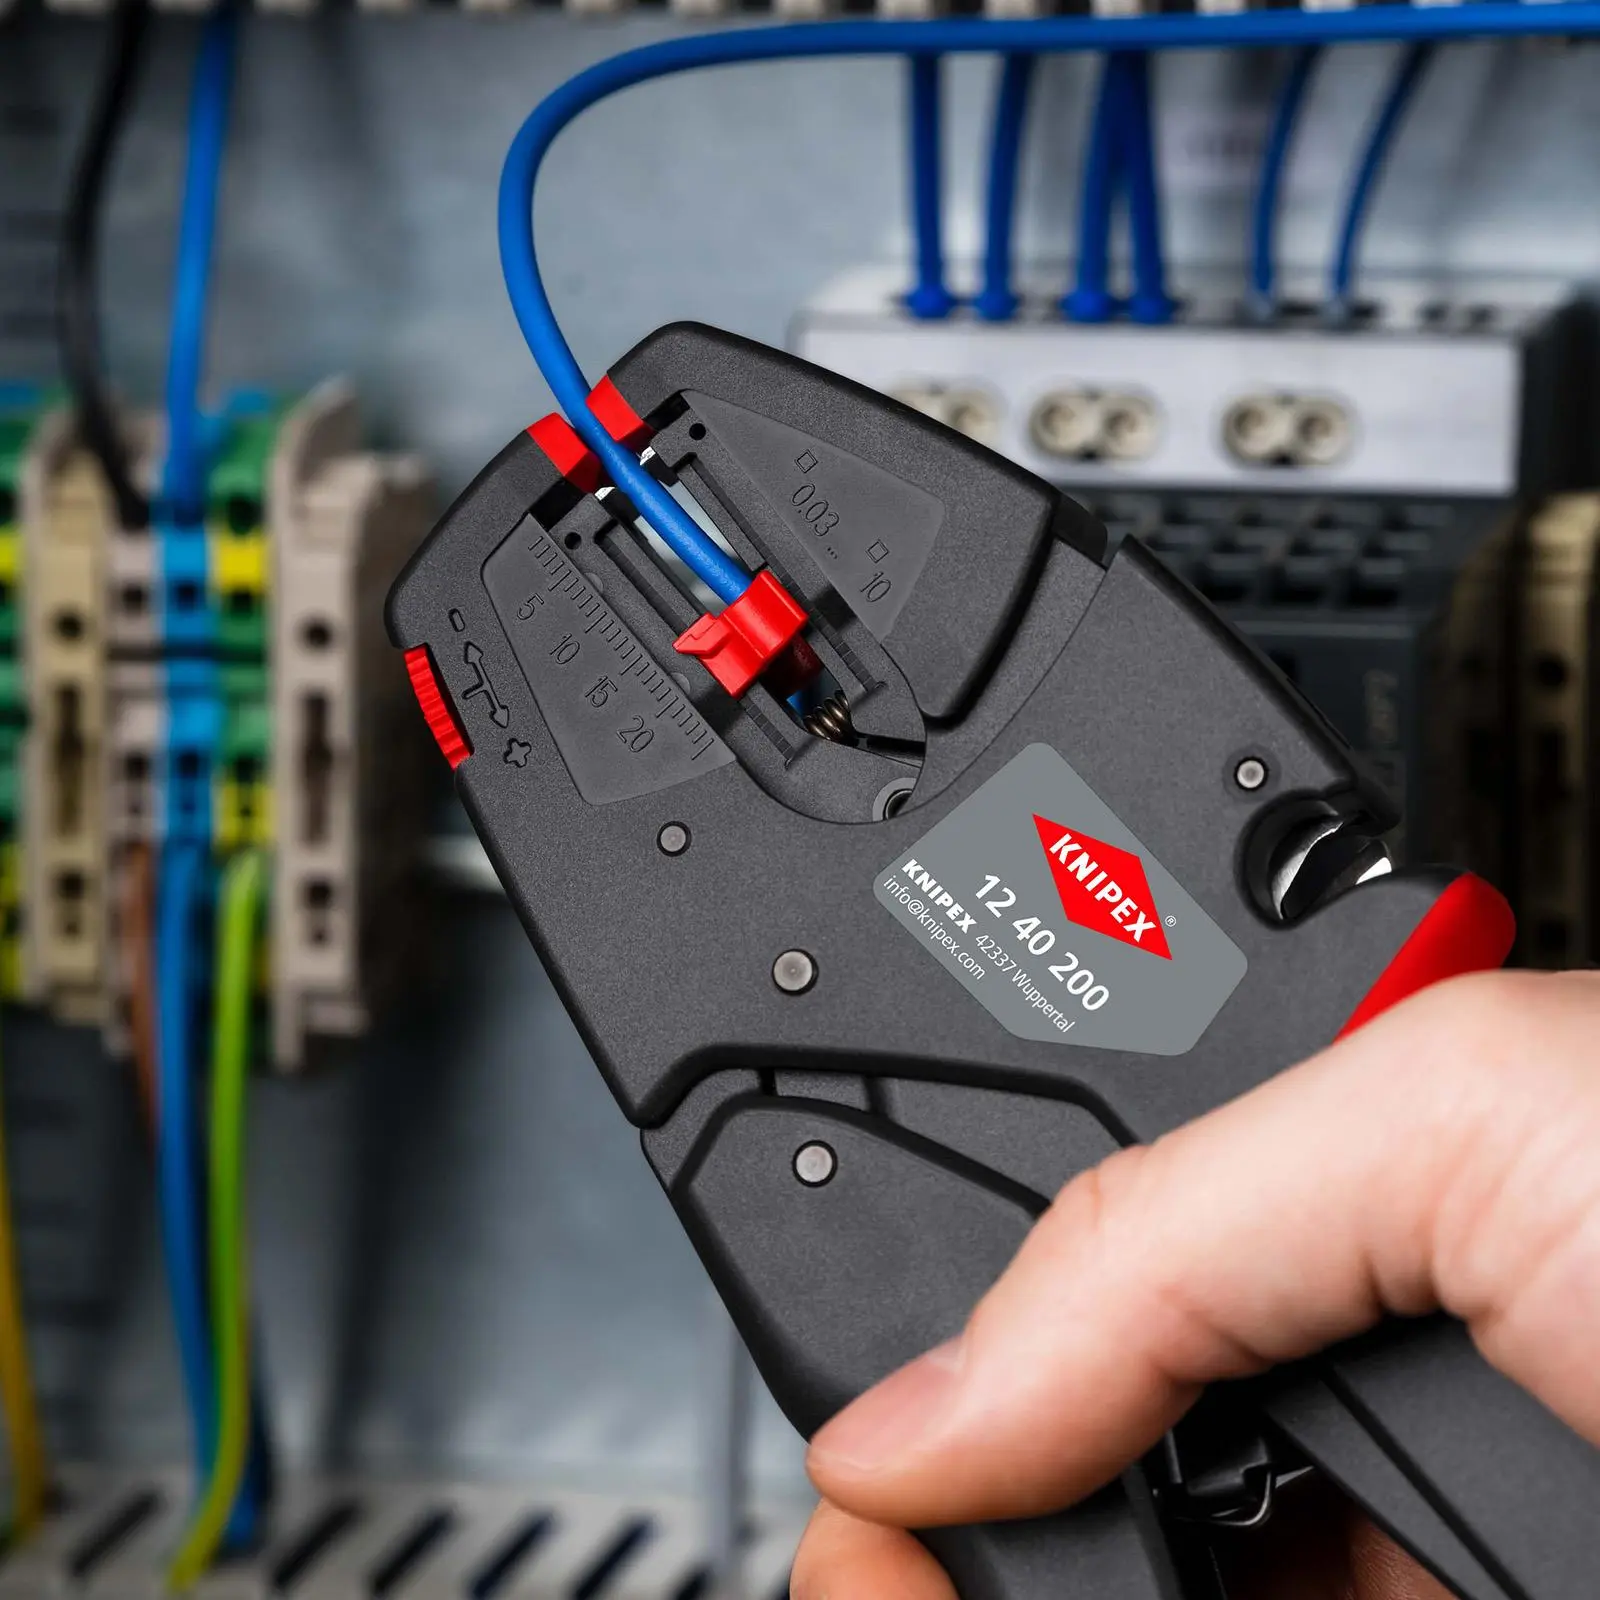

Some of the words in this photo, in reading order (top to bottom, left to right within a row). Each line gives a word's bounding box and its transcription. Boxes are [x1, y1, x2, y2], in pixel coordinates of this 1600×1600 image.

[860, 571, 892, 603] 10
[516, 593, 545, 622] 5
[549, 633, 581, 665] 10
[583, 676, 618, 708] 15
[616, 715, 655, 753] 20
[1049, 833, 1156, 943] KNIPEX
[883, 875, 986, 980] info@knipex.com
[901, 858, 977, 934] KNIPEX
[976, 934, 1017, 972] 42337
[1013, 969, 1075, 1033] Wuppertal
[975, 874, 1017, 918] 12
[1012, 915, 1056, 956] 40
[1048, 952, 1109, 1012] 200
